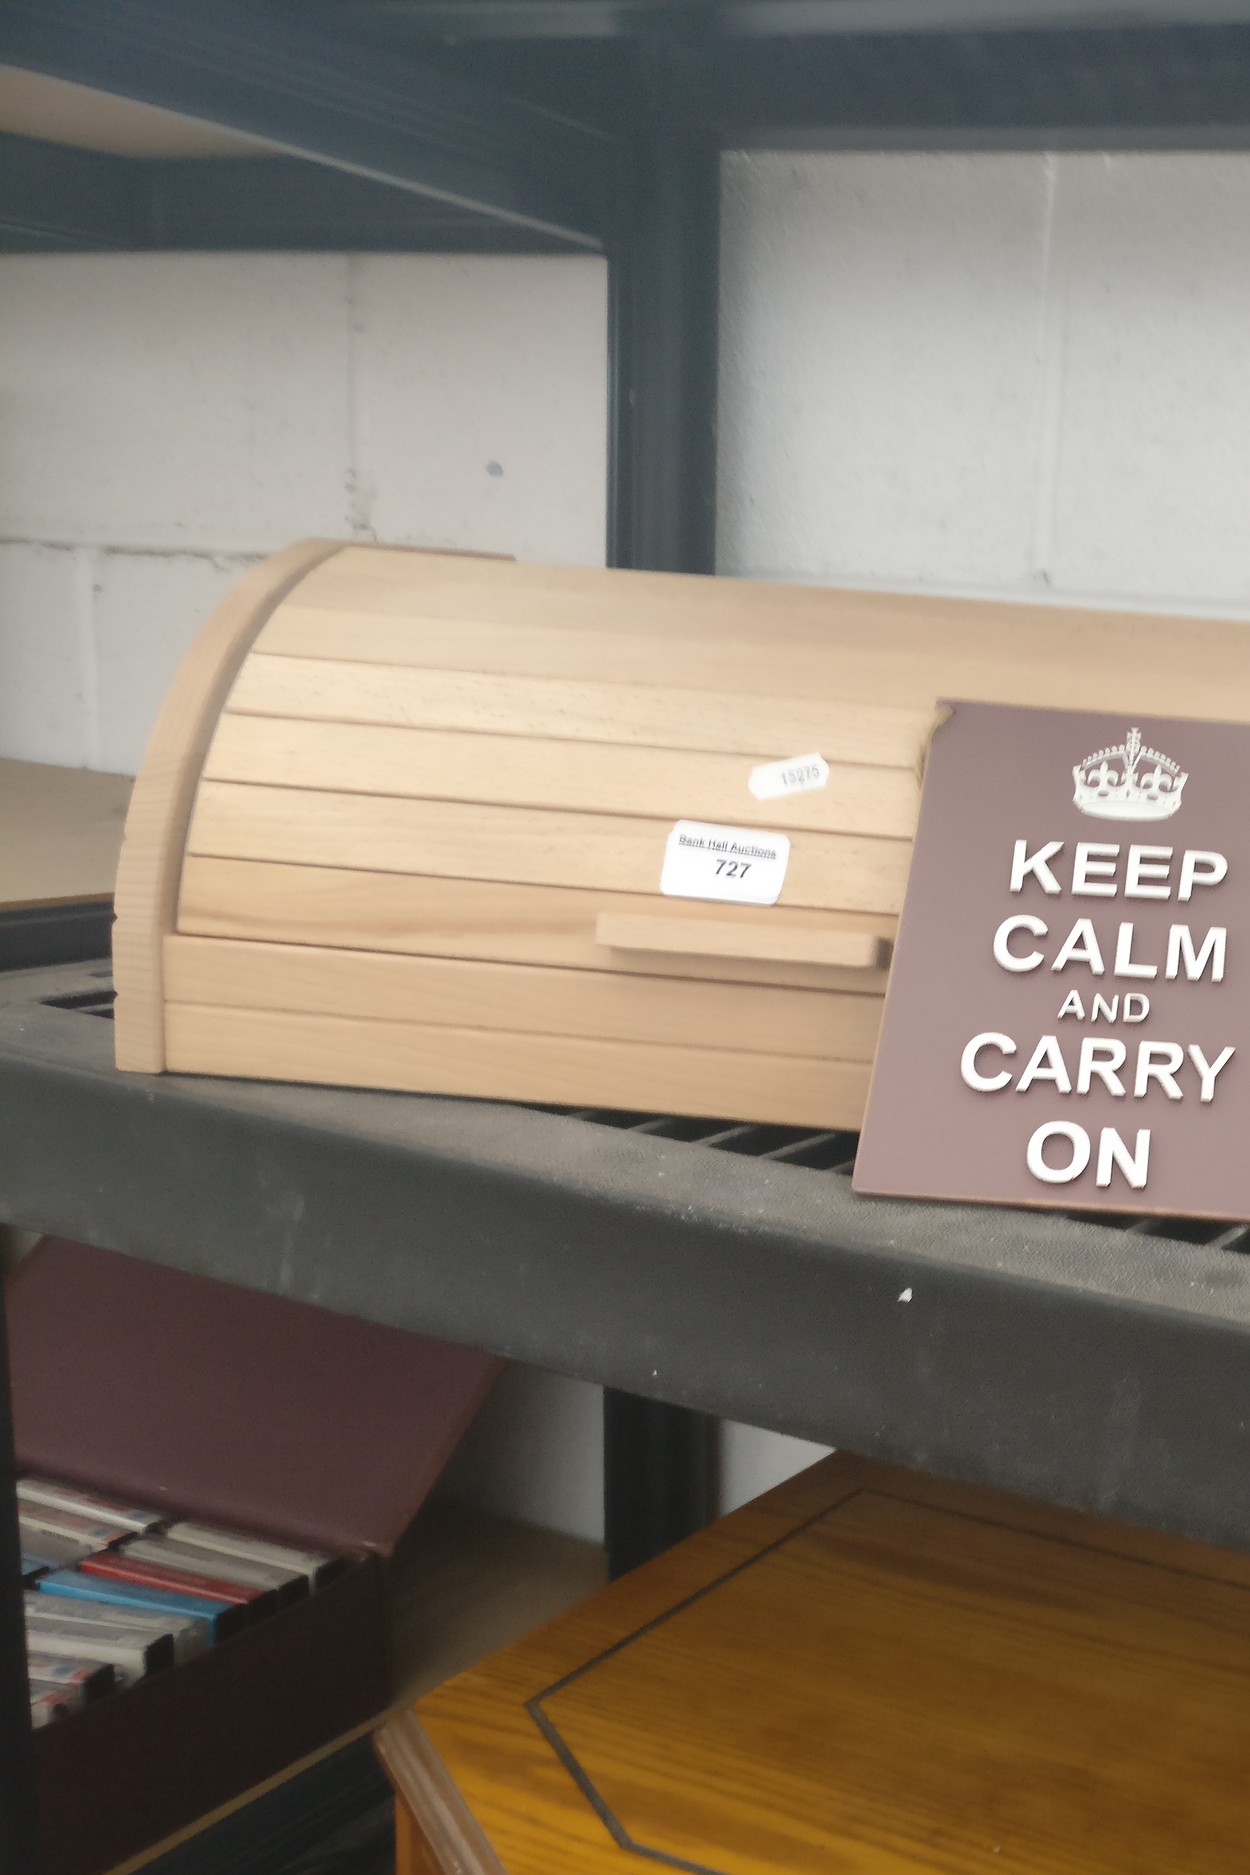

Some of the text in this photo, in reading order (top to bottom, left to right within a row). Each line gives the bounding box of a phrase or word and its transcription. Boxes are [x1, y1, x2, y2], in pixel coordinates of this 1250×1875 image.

[781, 764, 821, 785] 15275
[679, 834, 776, 858] Bank Hall Auctions
[715, 859, 752, 878] 727
[1009, 839, 1228, 902] KEEP
[992, 914, 1227, 983] CALM
[1056, 988, 1151, 1024] AND
[960, 1031, 1236, 1103] CARRY
[1025, 1119, 1152, 1190] ON
